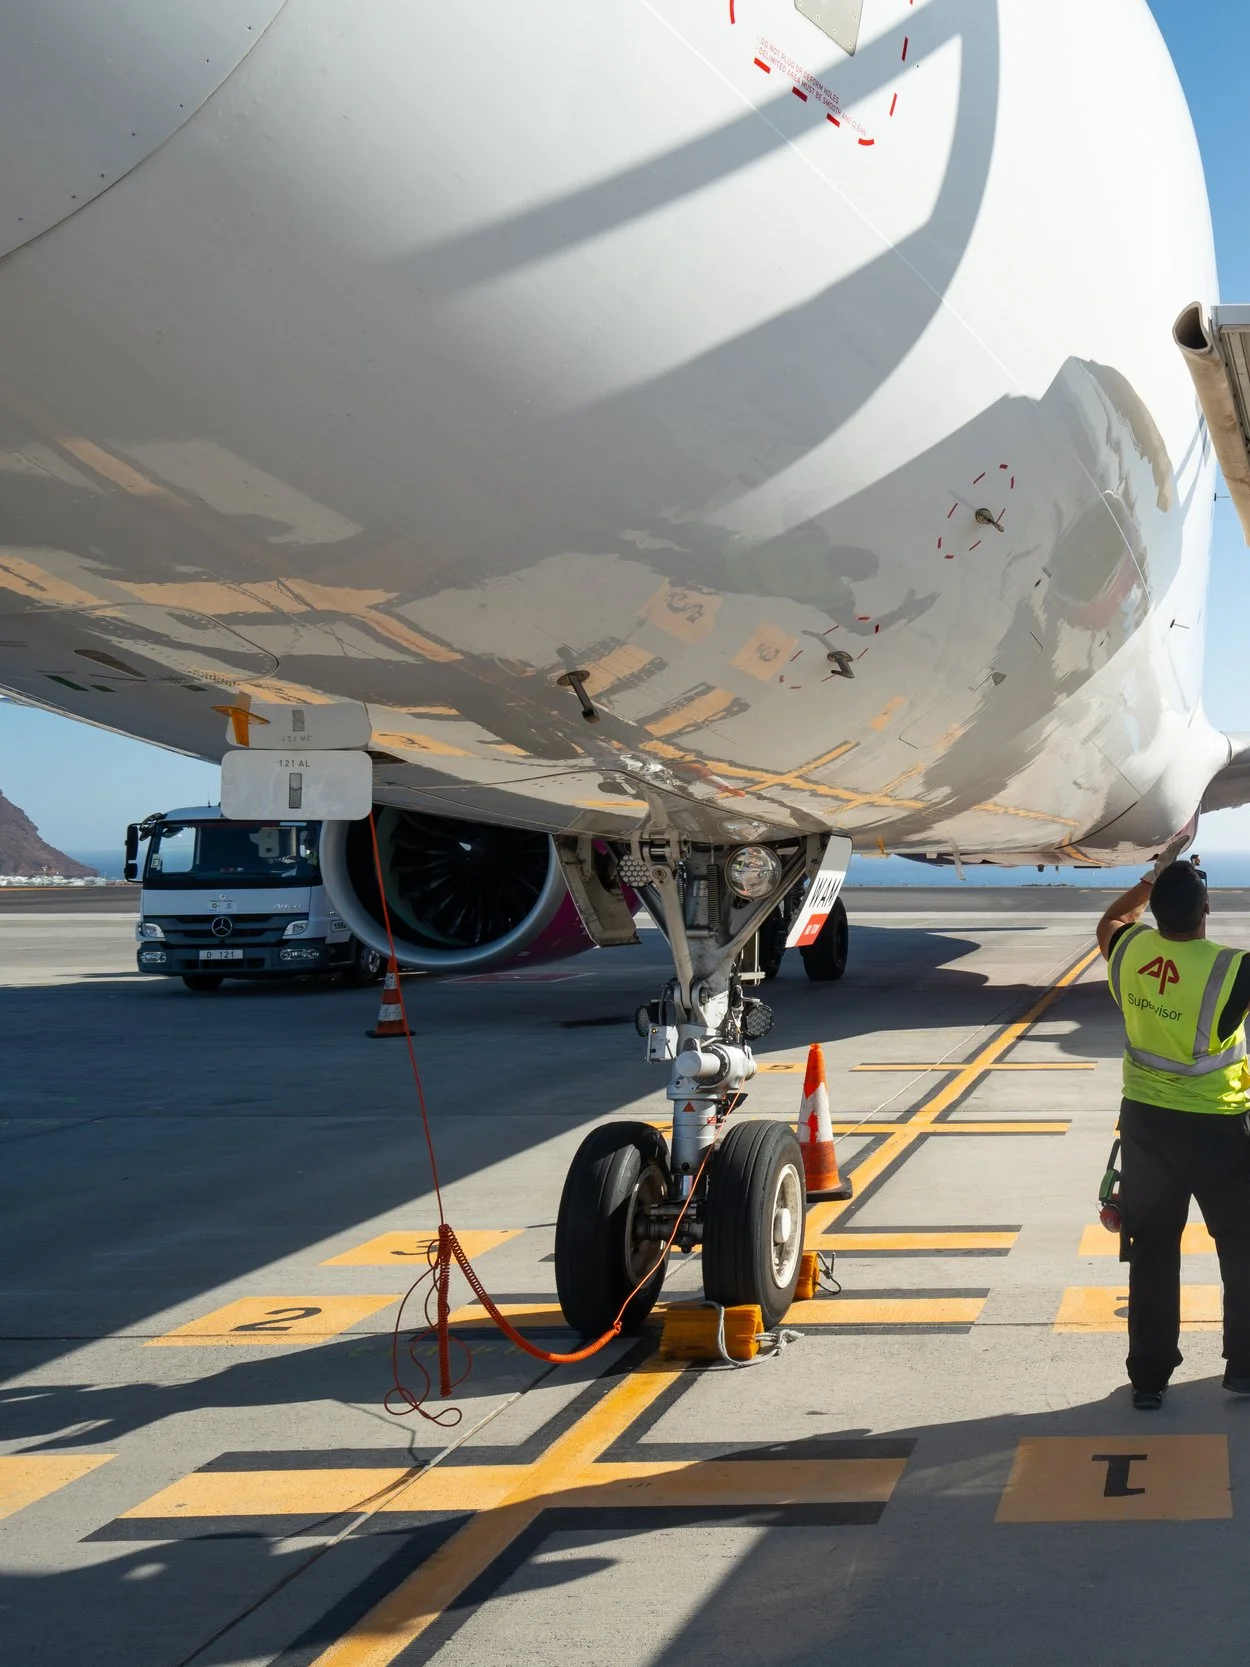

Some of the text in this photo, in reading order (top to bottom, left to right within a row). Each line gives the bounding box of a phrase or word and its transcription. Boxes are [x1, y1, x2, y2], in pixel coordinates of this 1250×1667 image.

[758, 46, 786, 73] DELIMITED
[787, 68, 800, 84] AREA
[800, 80, 815, 96] MUST
[822, 96, 841, 116] SMOOTH
[803, 69, 824, 92] DEFORM
[824, 84, 840, 104] HOLES
[280, 760, 311, 768] 121 AL
[1128, 993, 1182, 1020] Supevisor
[229, 1306, 322, 1332] 2
[1091, 1454, 1148, 1498] 1
